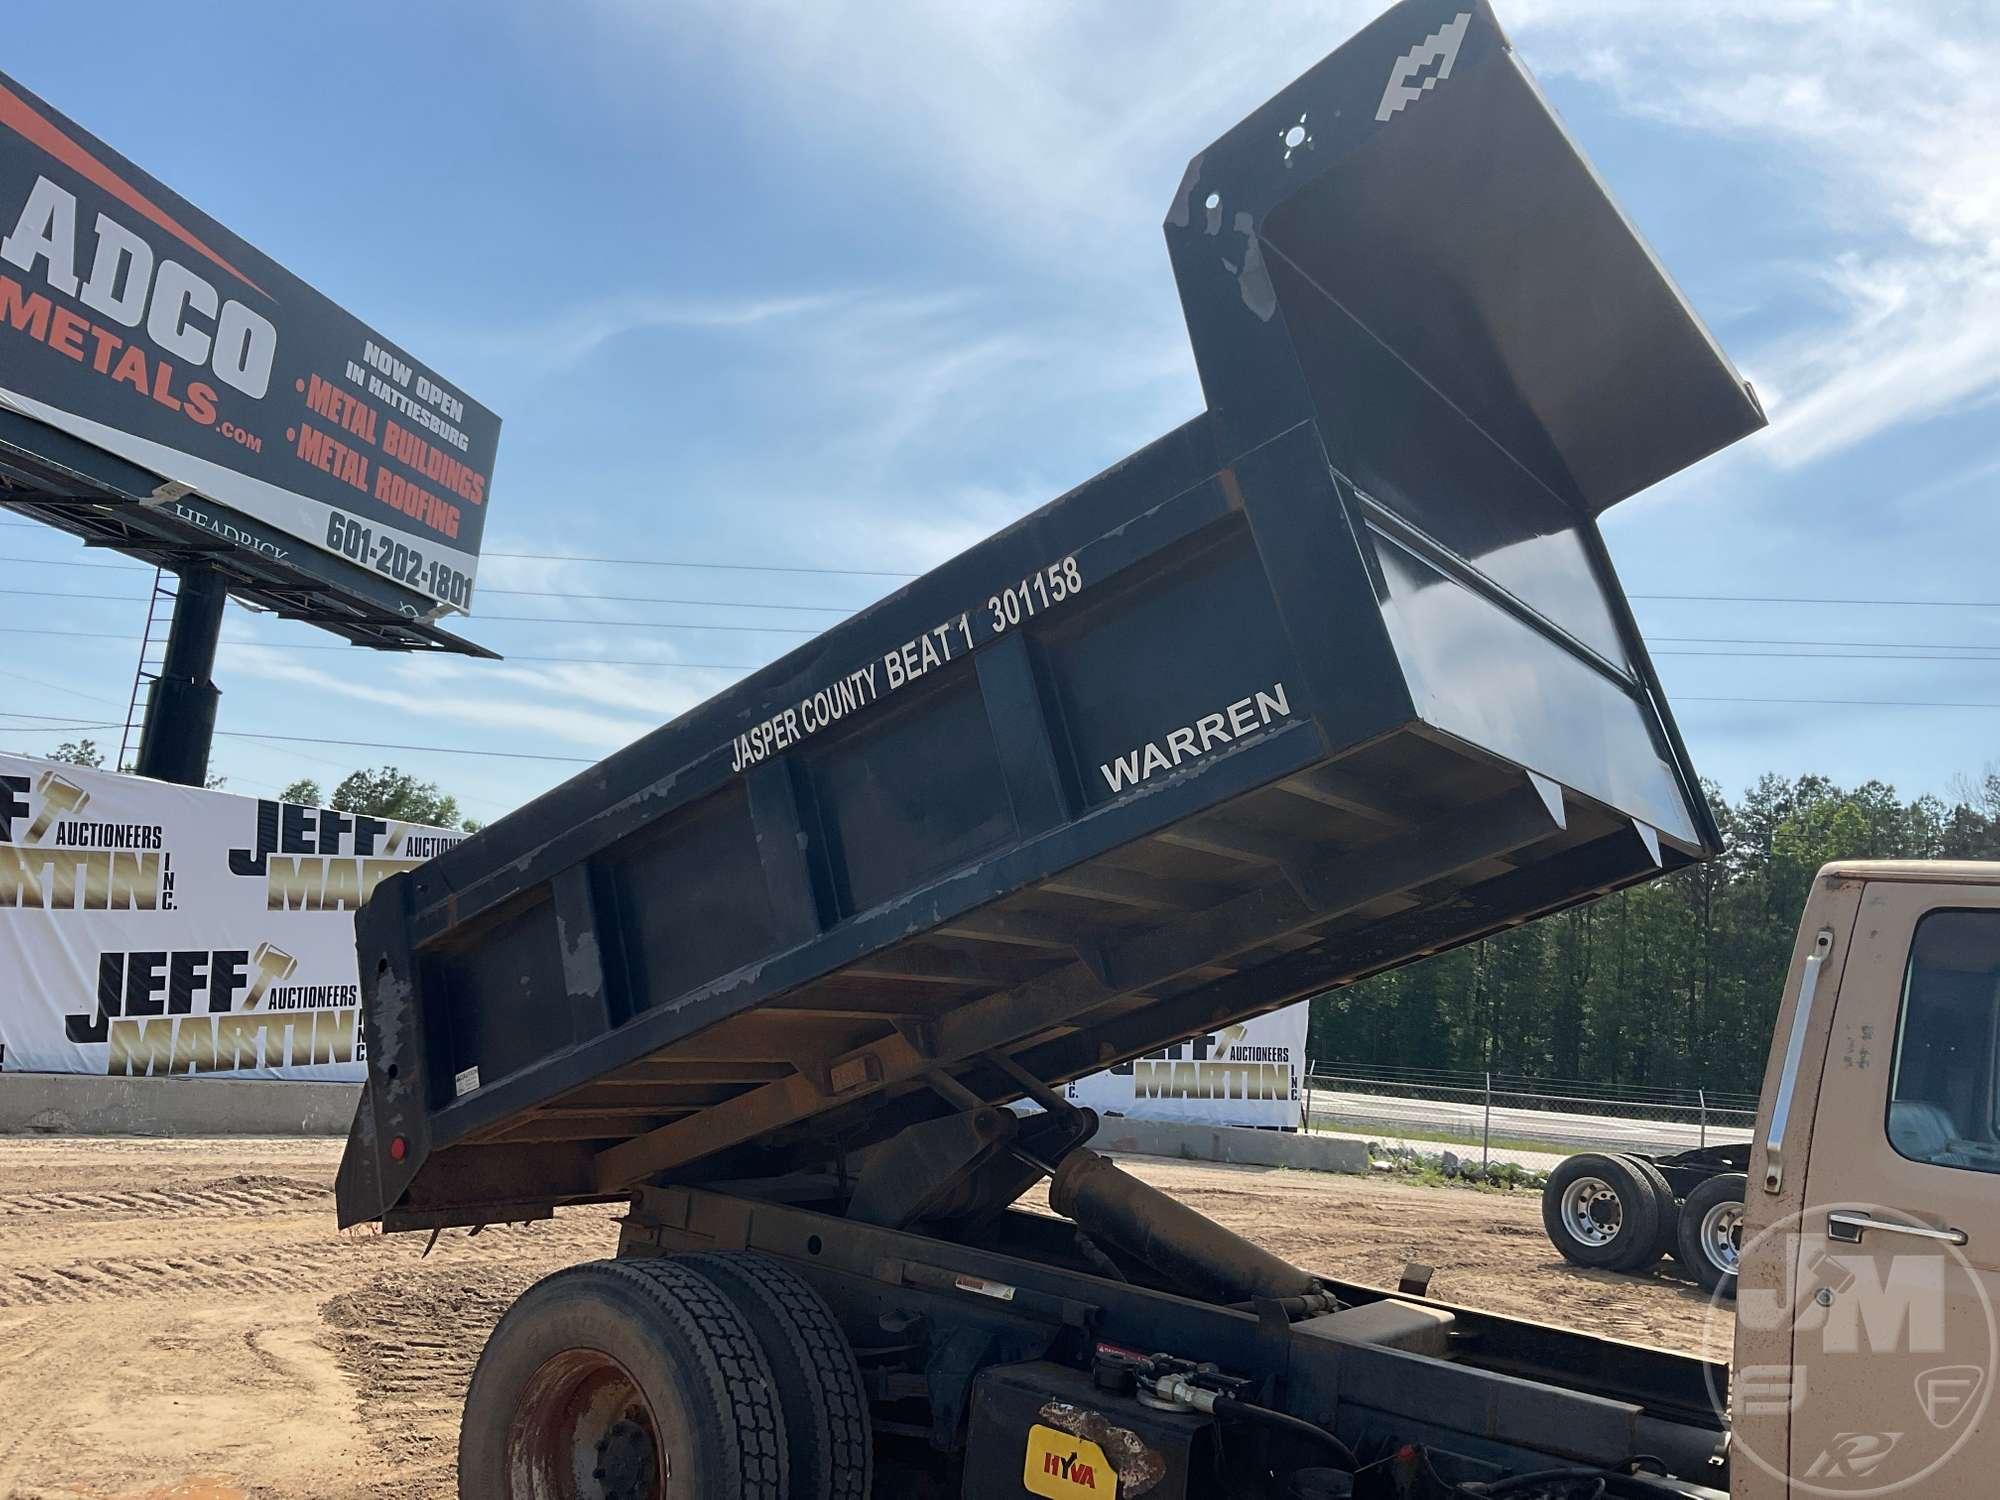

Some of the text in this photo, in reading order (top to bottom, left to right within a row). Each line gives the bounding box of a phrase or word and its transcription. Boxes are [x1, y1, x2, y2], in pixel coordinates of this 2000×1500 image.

[0, 175, 277, 400] ADCO
[345, 360, 469, 452] IN HATTIESBURG
[363, 340, 463, 423] NOW OPEN
[297, 424, 461, 539] METAL ROOFING
[306, 373, 485, 505] METAL BUILDINGS
[326, 511, 472, 609] 601-202-1801
[732, 556, 1082, 772] JASPER COUNTY BEAT 1 301158
[1100, 683, 1291, 793] WARREN
[56, 821, 162, 849] AUCTIONEERS
[228, 799, 387, 875] JEFF
[65, 951, 249, 1043] JEFF
[268, 985, 357, 1010] AUCTIONEERS
[108, 1009, 355, 1076] MARTIN
[1135, 1061, 1289, 1100] MARTIN
[1229, 1046, 1289, 1062] AUCTIONEERS
[1044, 1452, 1096, 1489] HYVA
